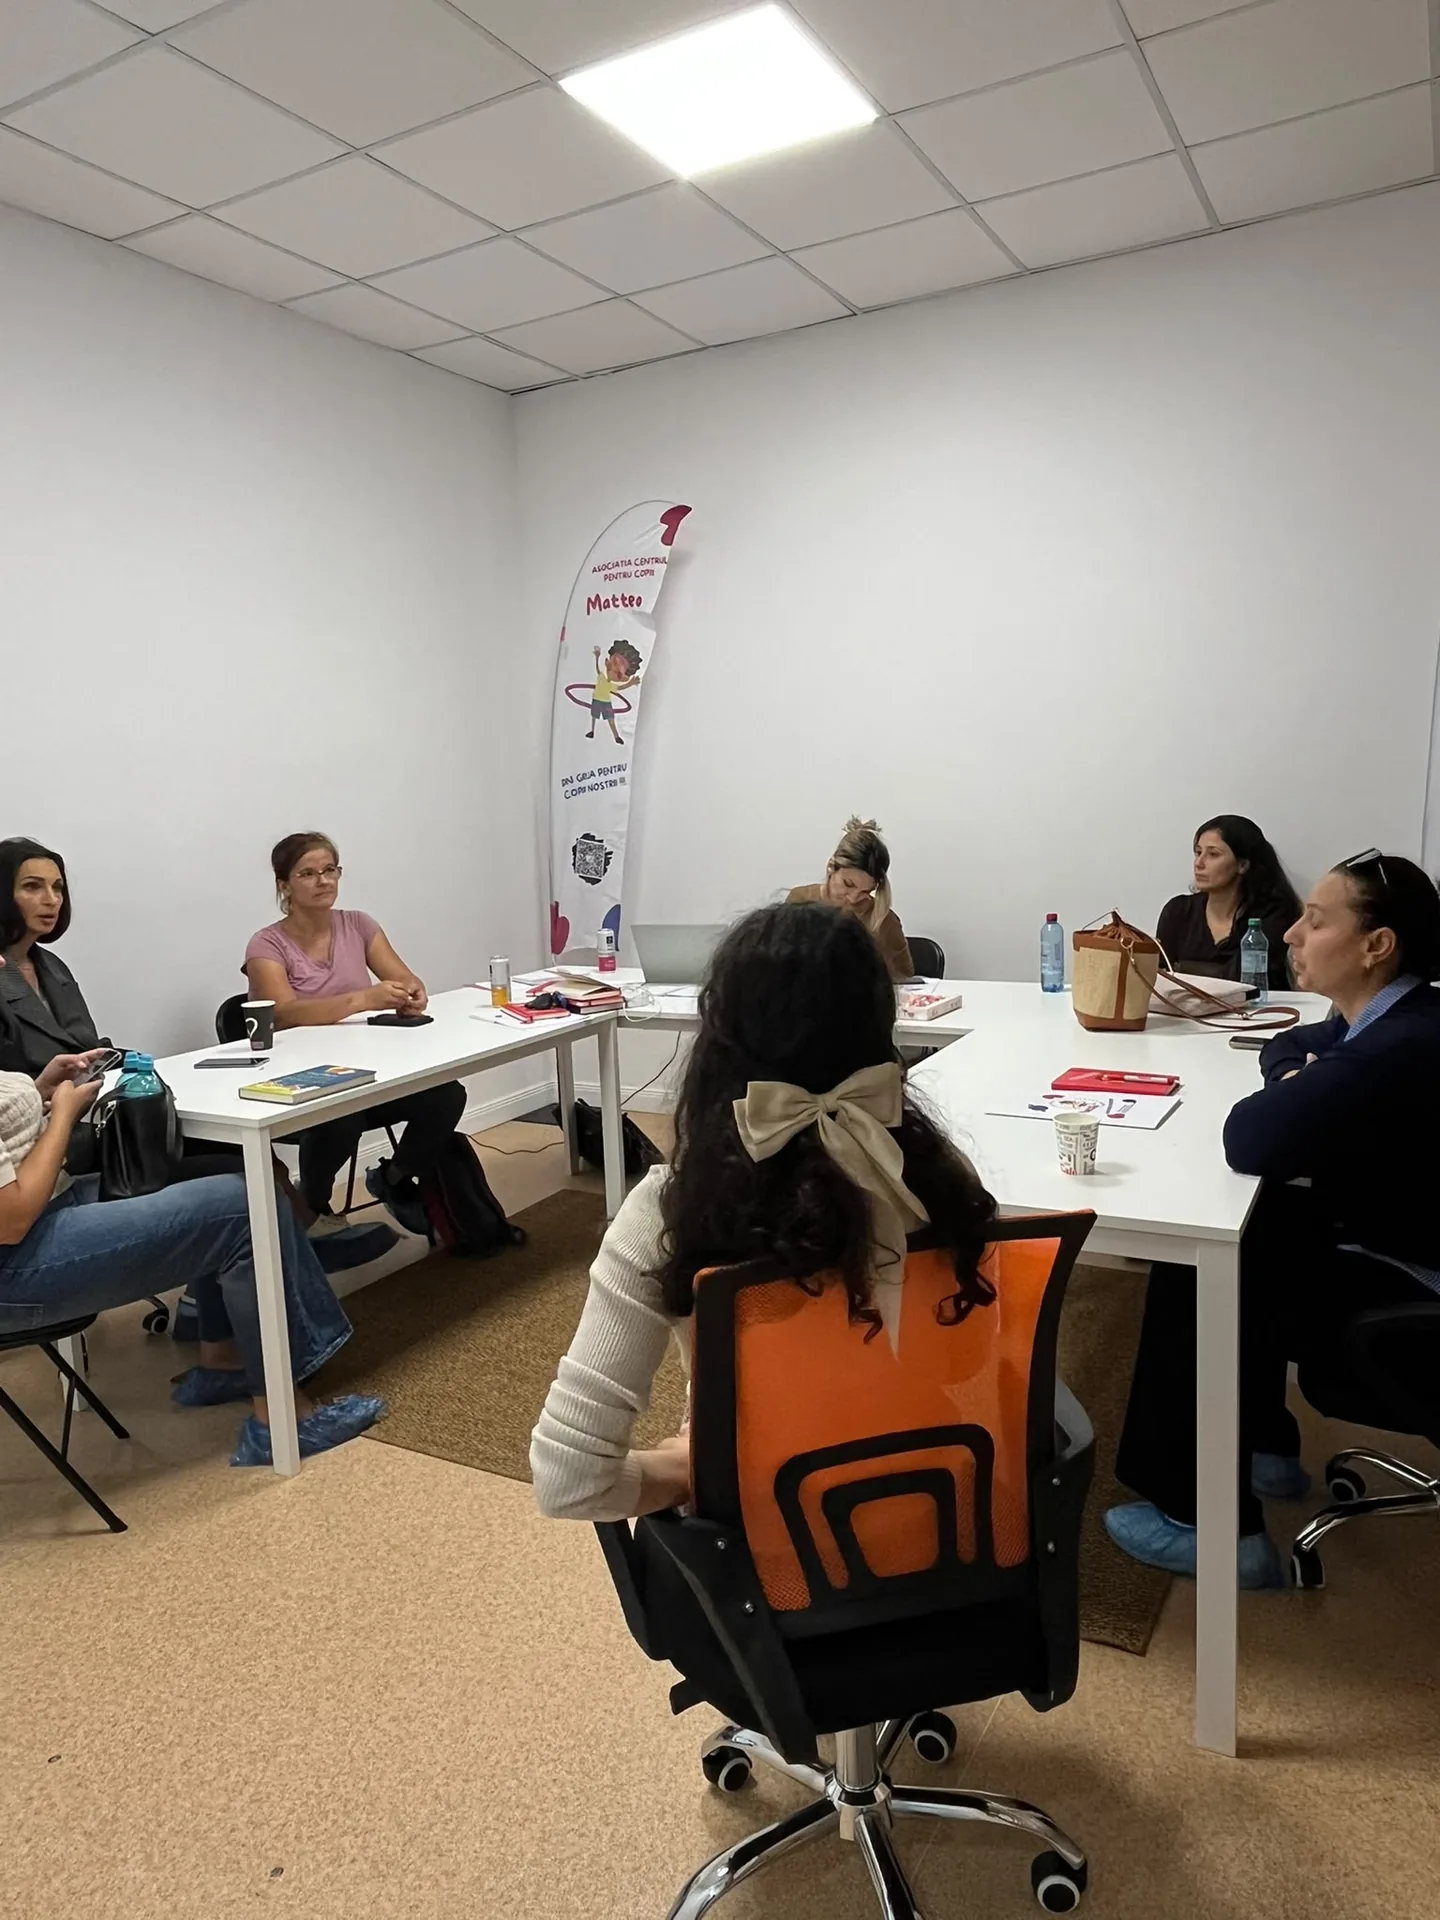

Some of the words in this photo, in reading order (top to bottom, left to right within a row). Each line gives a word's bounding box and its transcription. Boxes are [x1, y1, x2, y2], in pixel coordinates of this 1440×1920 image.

[634, 557, 667, 567] CENTRUL
[603, 572, 632, 582] PENTRU
[634, 569, 655, 578] COPII
[586, 593, 642, 615] Matteo
[597, 763, 627, 776] PENTRU
